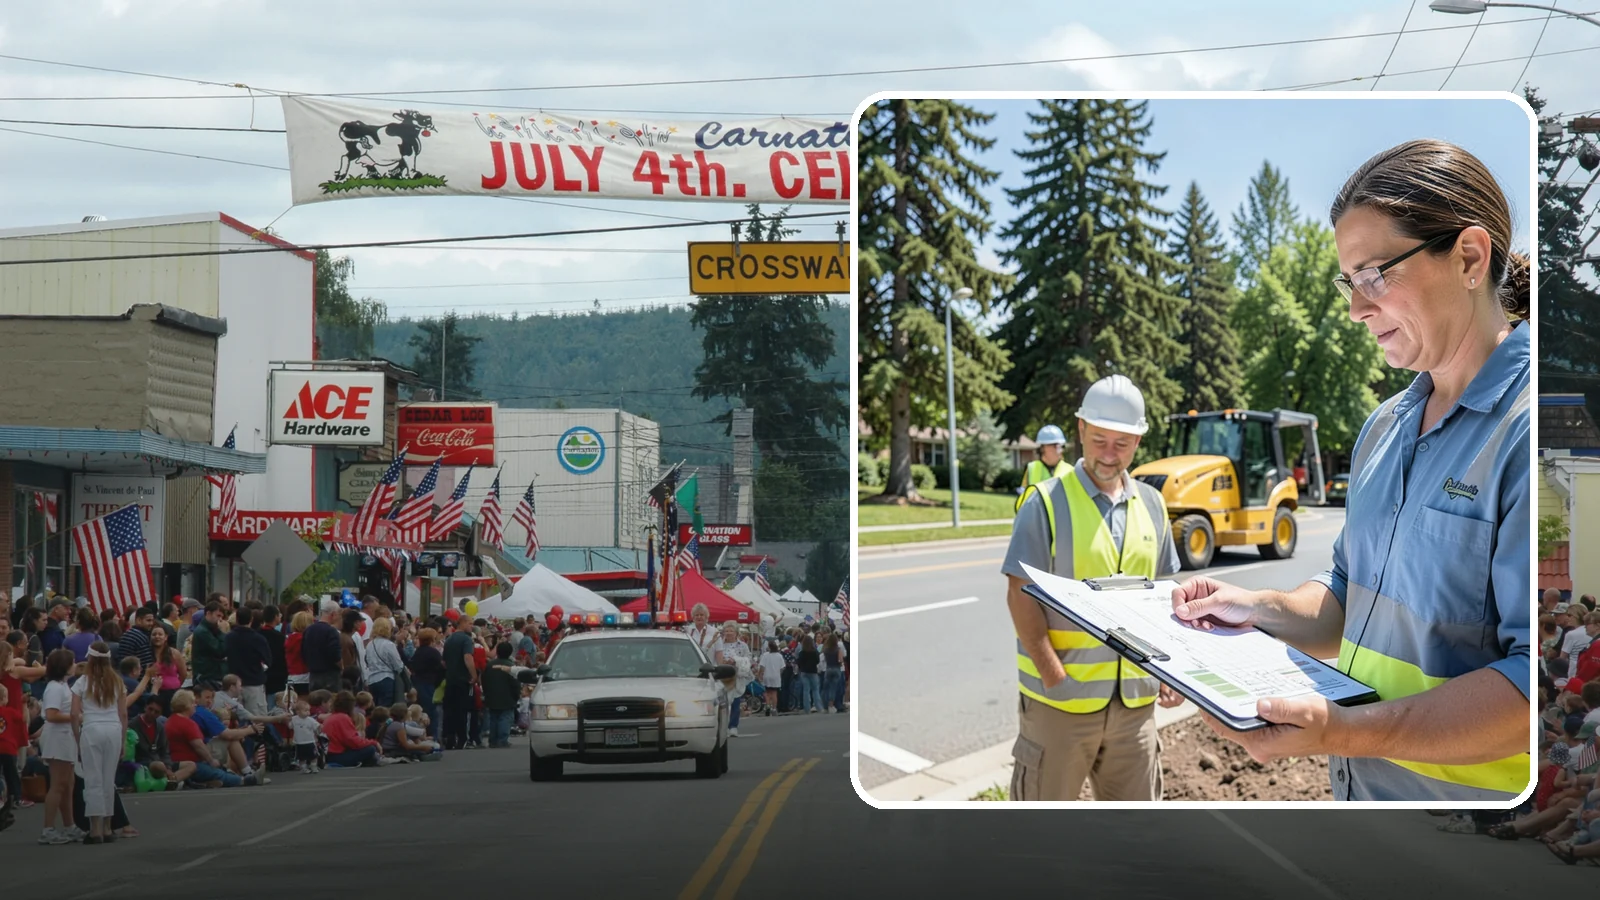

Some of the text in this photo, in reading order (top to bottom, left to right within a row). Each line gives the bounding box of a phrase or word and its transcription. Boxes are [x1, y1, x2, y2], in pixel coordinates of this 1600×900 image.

[481, 141, 604, 193] JULY
[632, 150, 746, 198] 4th.
[697, 254, 850, 280] CROSSWA
[283, 380, 373, 420] ACE
[405, 409, 485, 422] CEDAR LOG
[283, 421, 370, 436] Hardware
[416, 428, 477, 447] Coca-Cola
[353, 467, 387, 480] Simpl
[96, 485, 124, 495] Vincent
[126, 486, 136, 495] de
[138, 486, 155, 495] Paul
[699, 535, 730, 543] GLASS
